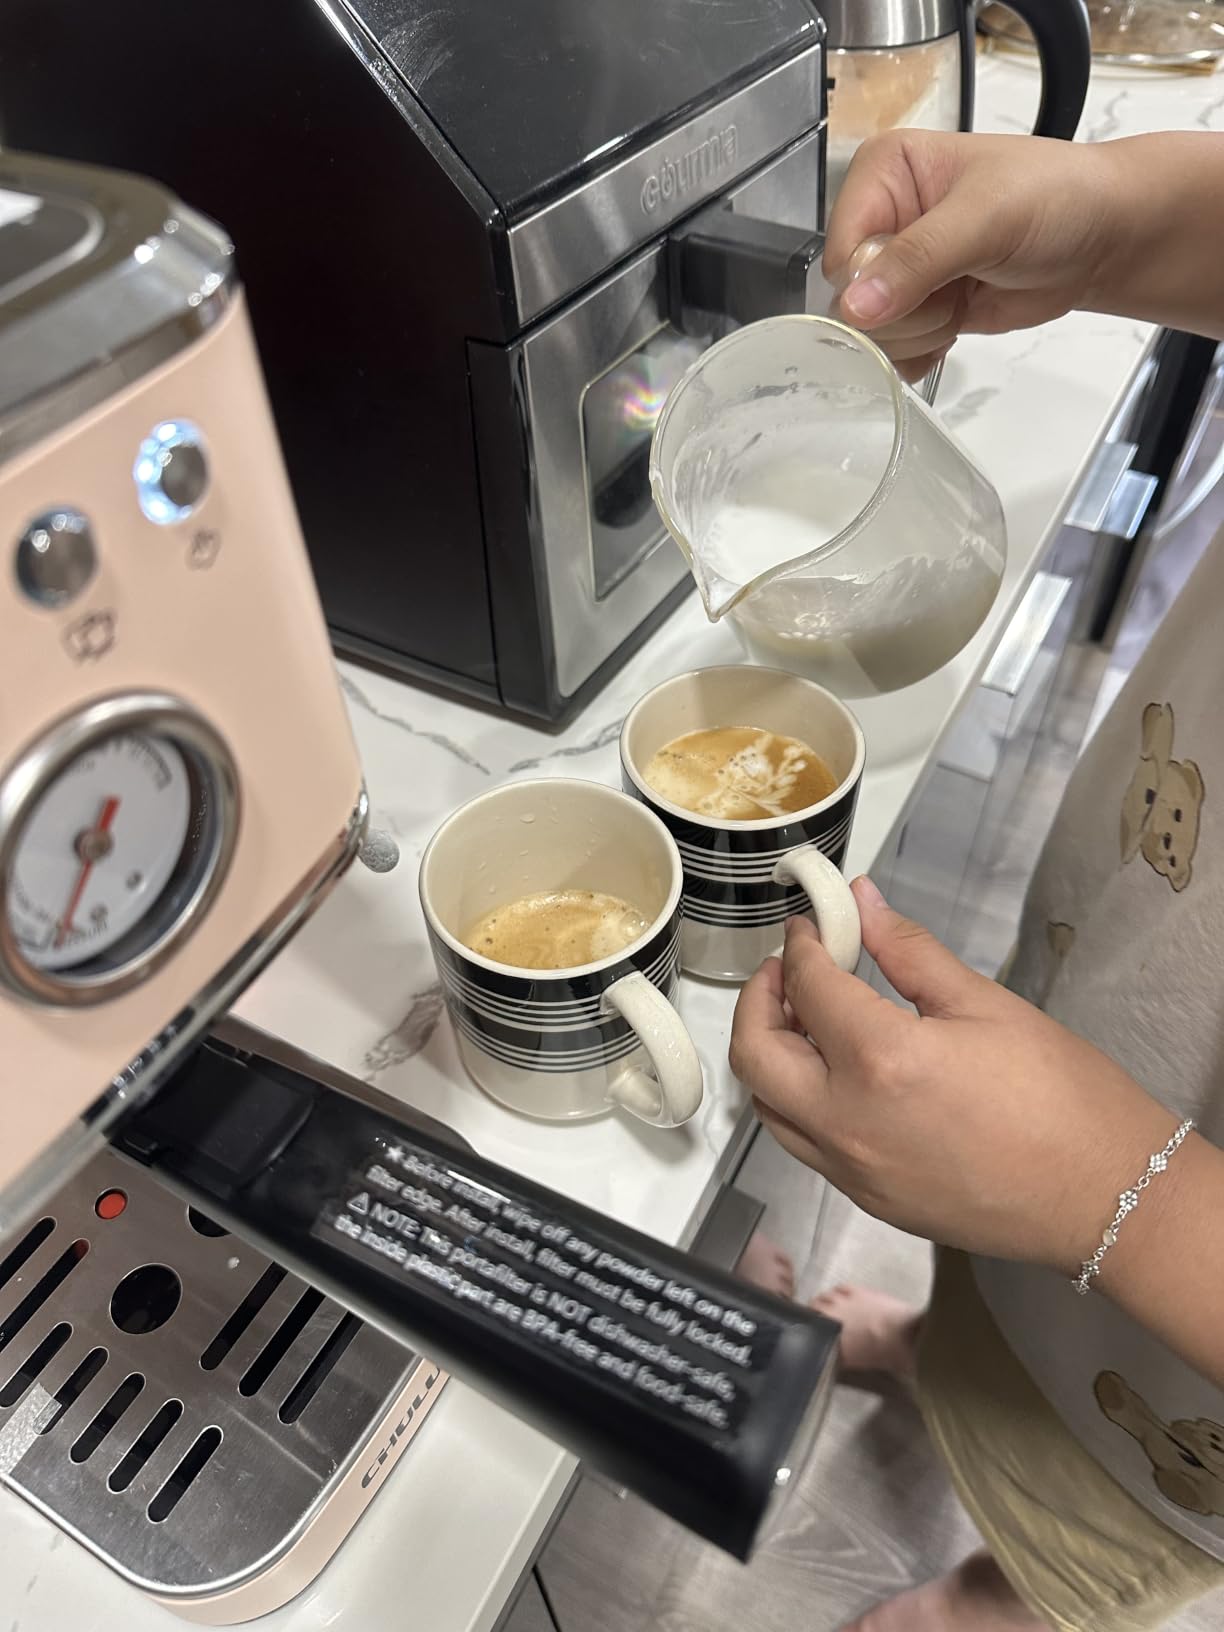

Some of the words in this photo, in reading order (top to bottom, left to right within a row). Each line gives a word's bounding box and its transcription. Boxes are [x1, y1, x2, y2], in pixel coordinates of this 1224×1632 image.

[334, 1213, 362, 1240] the
[359, 1223, 408, 1264] inside
[453, 1279, 496, 1309] part
[490, 1298, 524, 1323] are
[521, 1308, 600, 1361] BPA-free
[595, 1350, 640, 1380] and
[365, 1164, 404, 1193] filter
[443, 1203, 487, 1234] After
[482, 1221, 537, 1263] install,
[534, 1247, 579, 1280] filter
[573, 1270, 622, 1303] must
[619, 1288, 648, 1315] be
[643, 1301, 687, 1337] fully
[419, 1224, 455, 1257] This
[446, 1245, 533, 1297] portafilter
[528, 1281, 549, 1305] is
[546, 1291, 593, 1325] NOT
[501, 1205, 542, 1233] wipe
[541, 1223, 573, 1245] off
[564, 1236, 600, 1263] any
[593, 1251, 667, 1292] powder
[662, 1279, 698, 1309] left
[693, 1299, 724, 1321] on
[721, 1308, 758, 1337] the
[361, 1367, 441, 1489] CHULU
